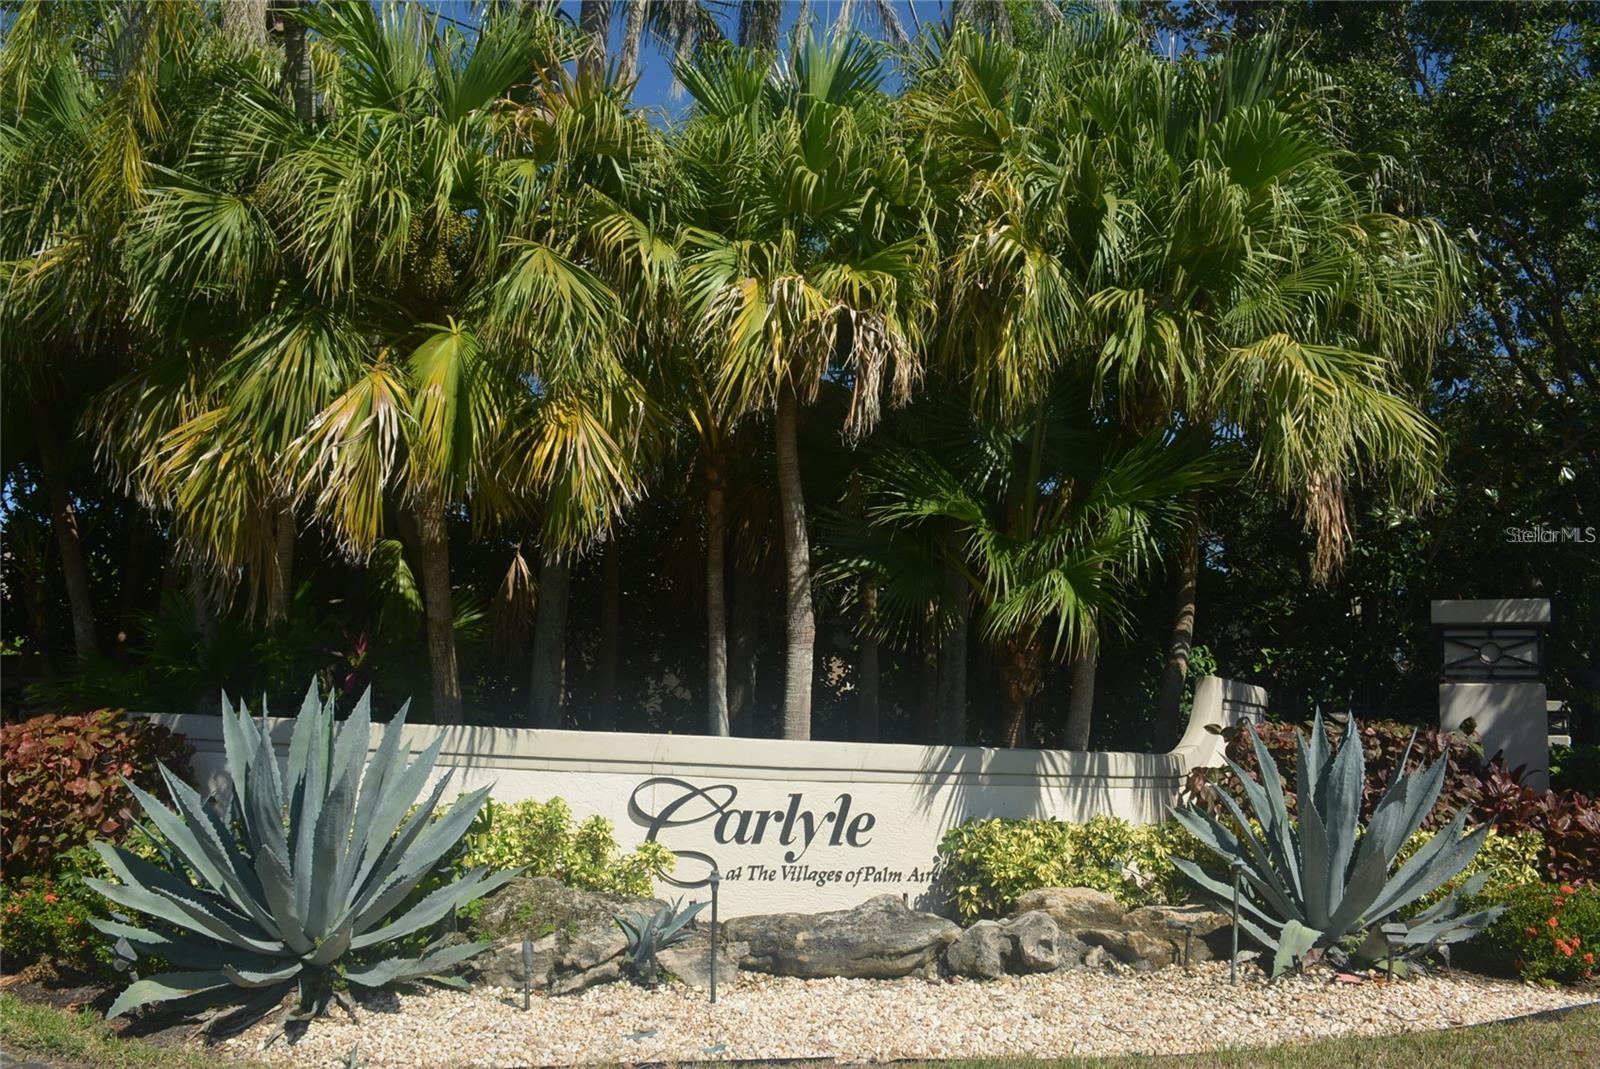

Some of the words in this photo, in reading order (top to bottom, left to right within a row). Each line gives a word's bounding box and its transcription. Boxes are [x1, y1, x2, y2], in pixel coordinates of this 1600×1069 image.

[627, 776, 876, 888] Carlyle
[725, 866, 742, 881] at
[747, 865, 777, 882] The
[781, 865, 842, 887] Villages
[845, 867, 864, 887] of
[864, 866, 902, 883] Palm
